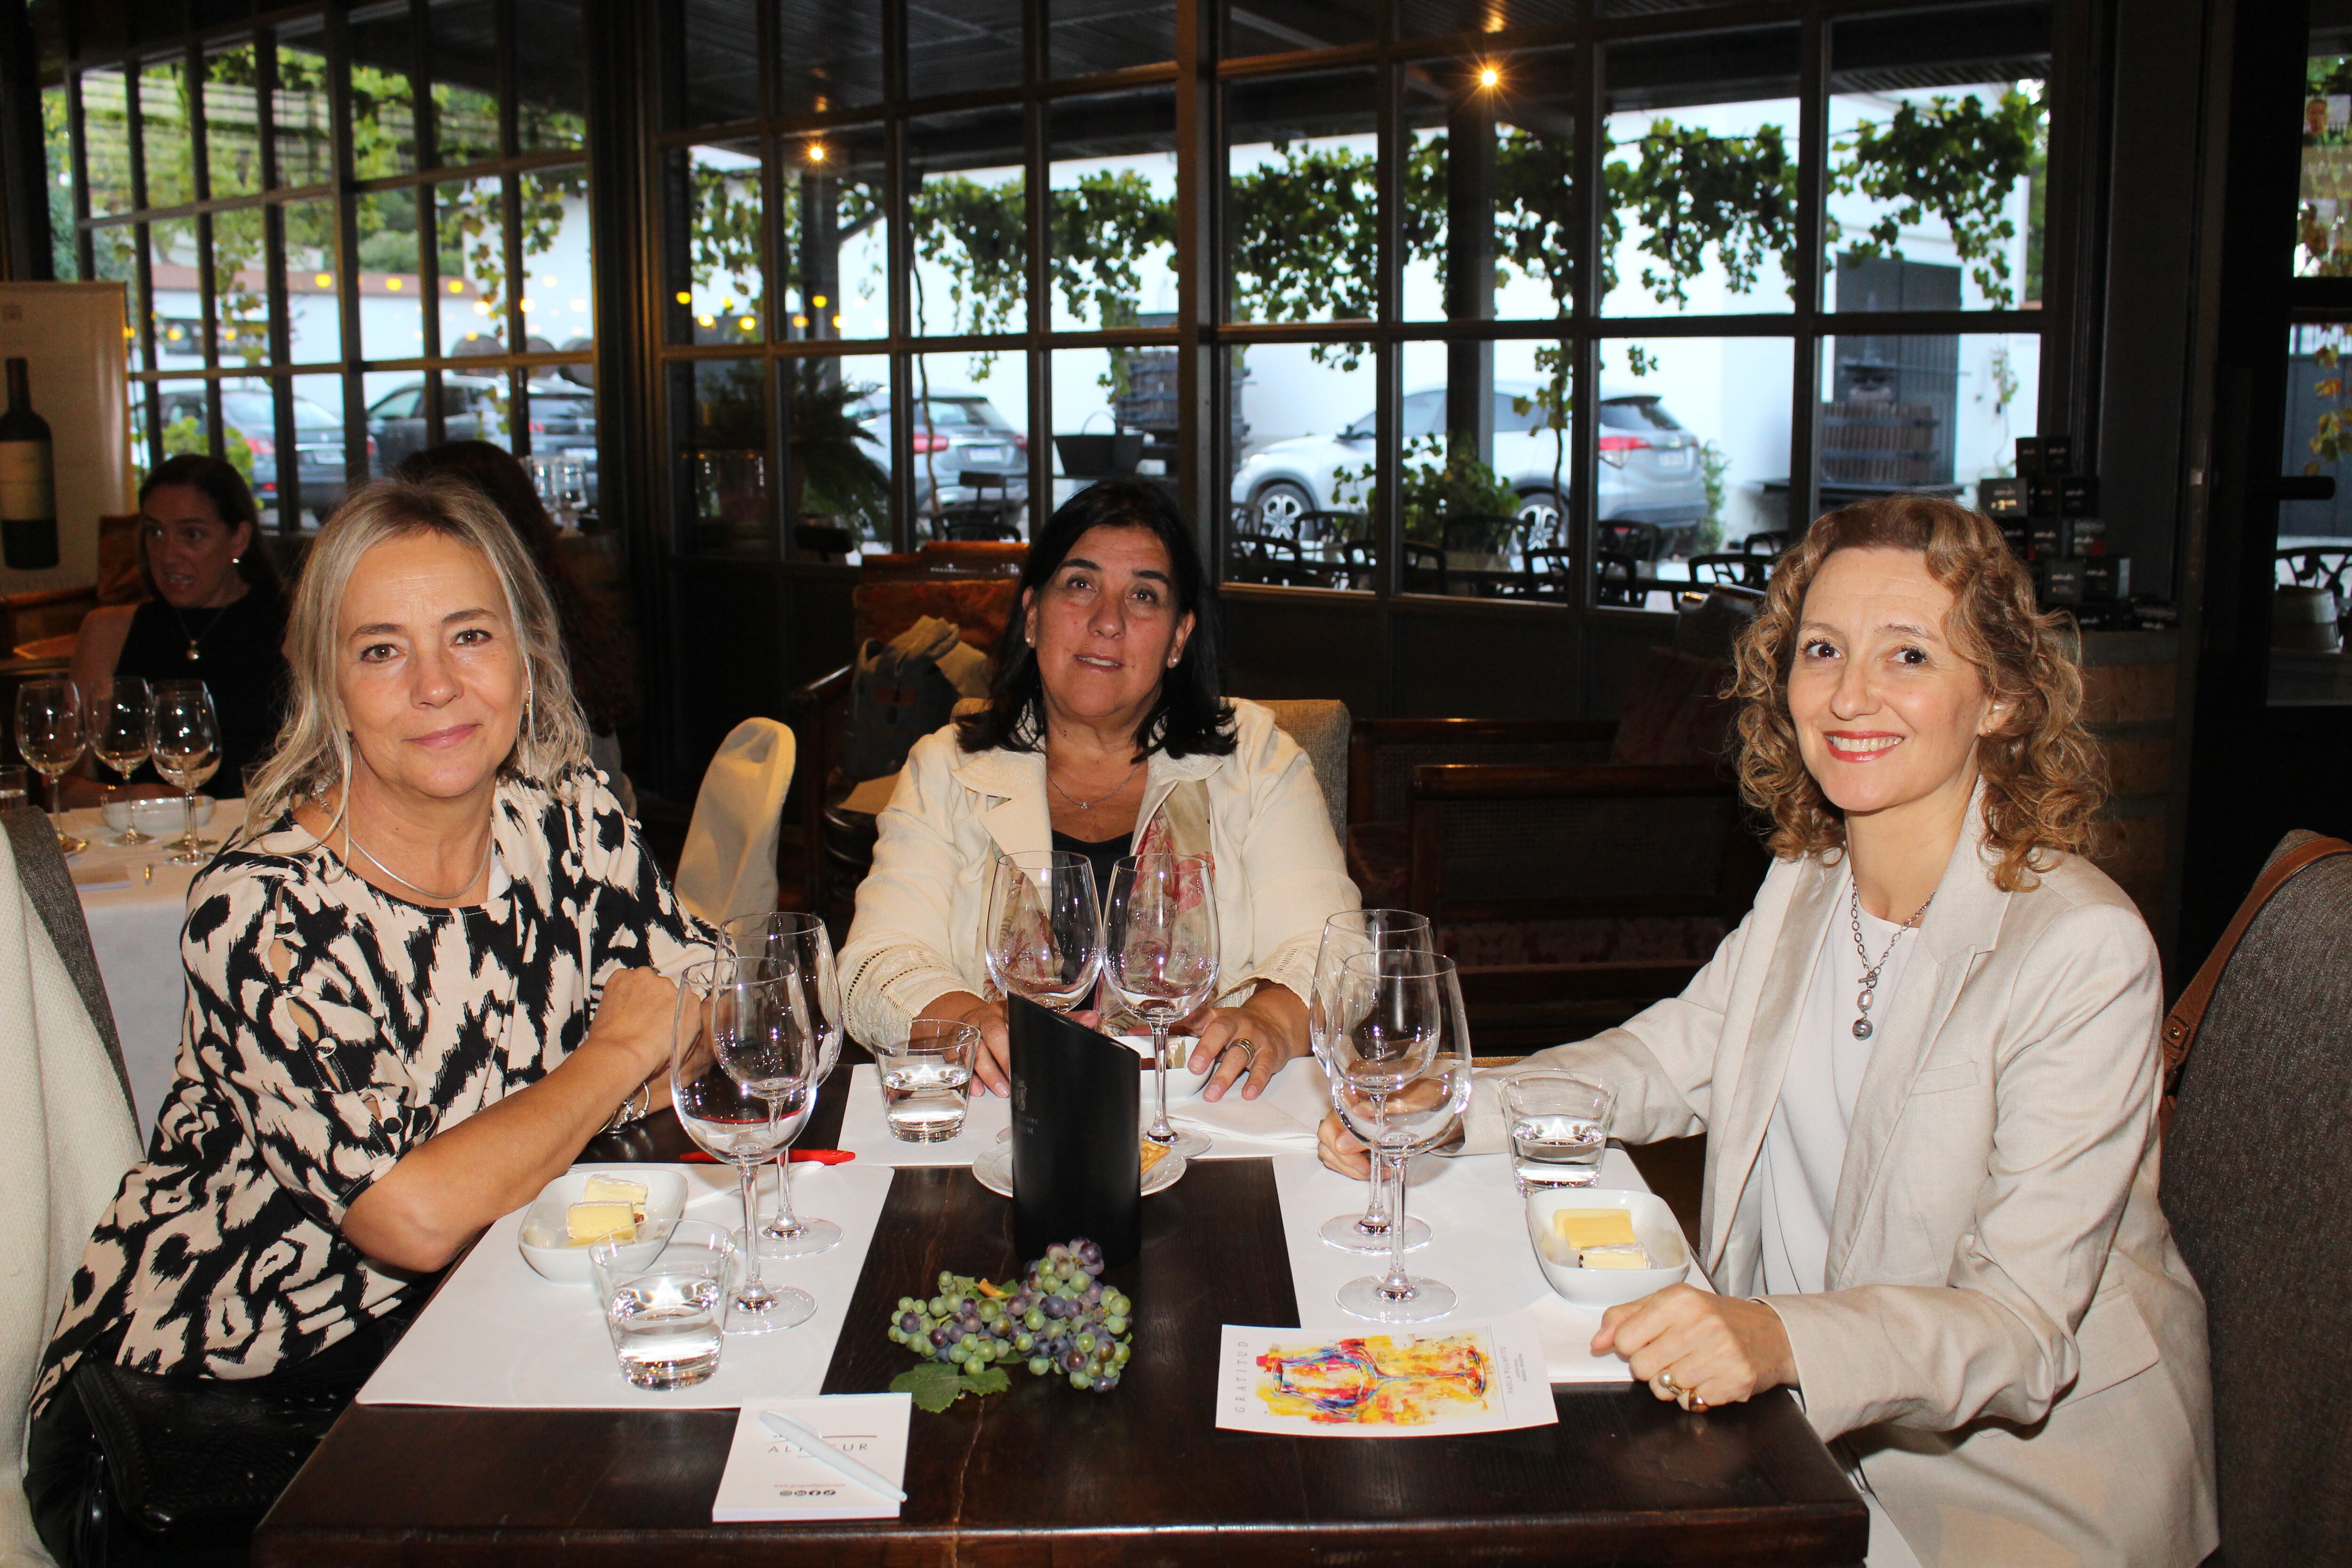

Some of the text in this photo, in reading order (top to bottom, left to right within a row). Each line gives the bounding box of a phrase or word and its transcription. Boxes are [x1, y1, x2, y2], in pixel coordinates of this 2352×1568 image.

[1234, 1341, 1248, 1413] GRATITUD
[1501, 1346, 1513, 1393] PAOLA PULIAFITO
